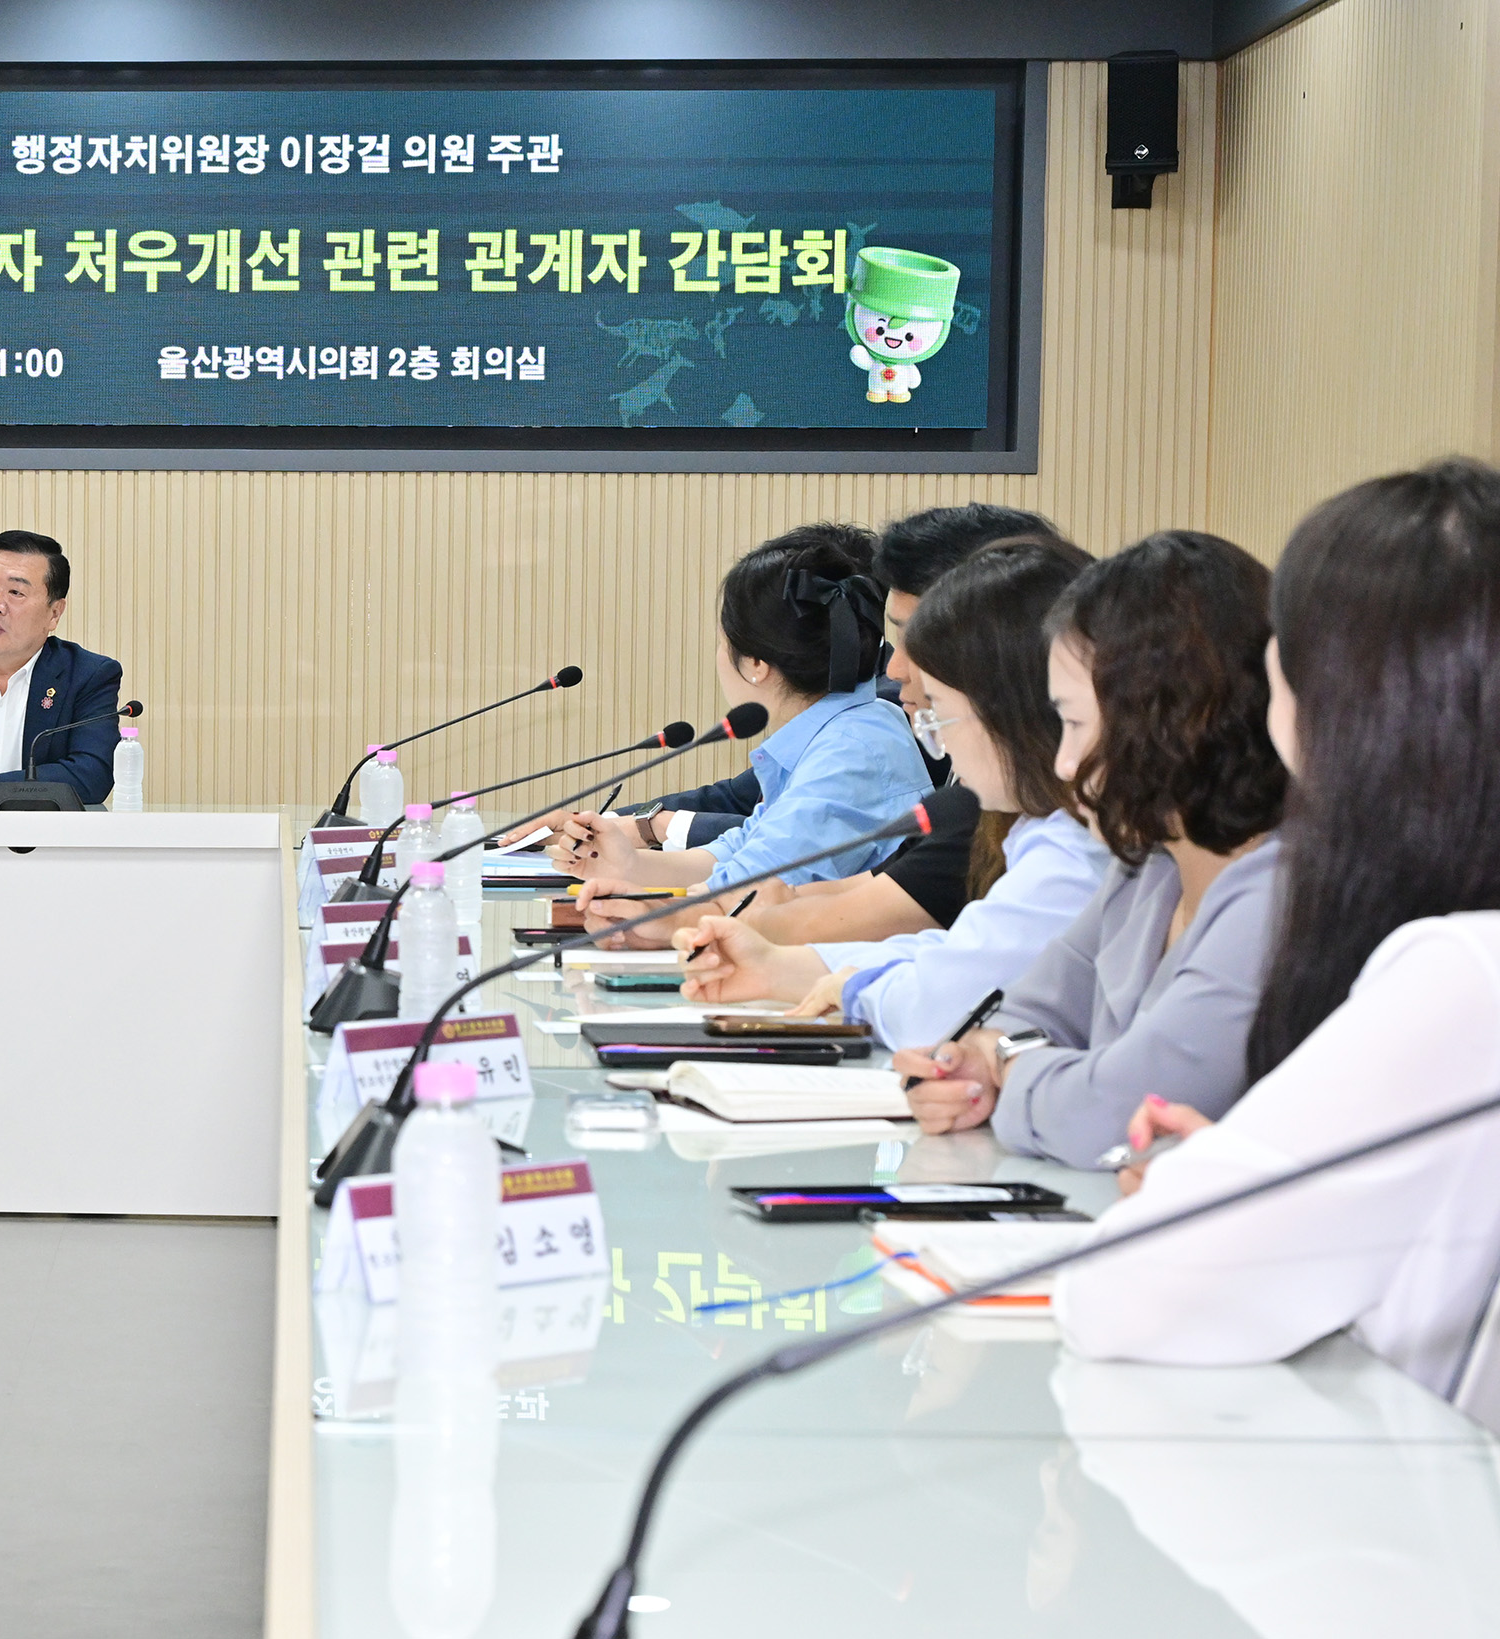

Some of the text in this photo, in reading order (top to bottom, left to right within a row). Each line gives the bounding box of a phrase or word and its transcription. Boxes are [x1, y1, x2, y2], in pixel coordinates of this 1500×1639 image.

[12, 134, 269, 175] 행정자치위원장
[281, 134, 390, 175] 이장걸
[403, 134, 475, 174] 의원
[488, 133, 563, 174] 주관
[64, 228, 301, 293] 처우개선
[322, 228, 440, 293] 관련
[464, 228, 647, 294] 관계자
[668, 228, 848, 294] 간담회
[157, 345, 379, 380] 울산광역시의회
[388, 345, 441, 381] 2층
[450, 346, 546, 381] 회의실
